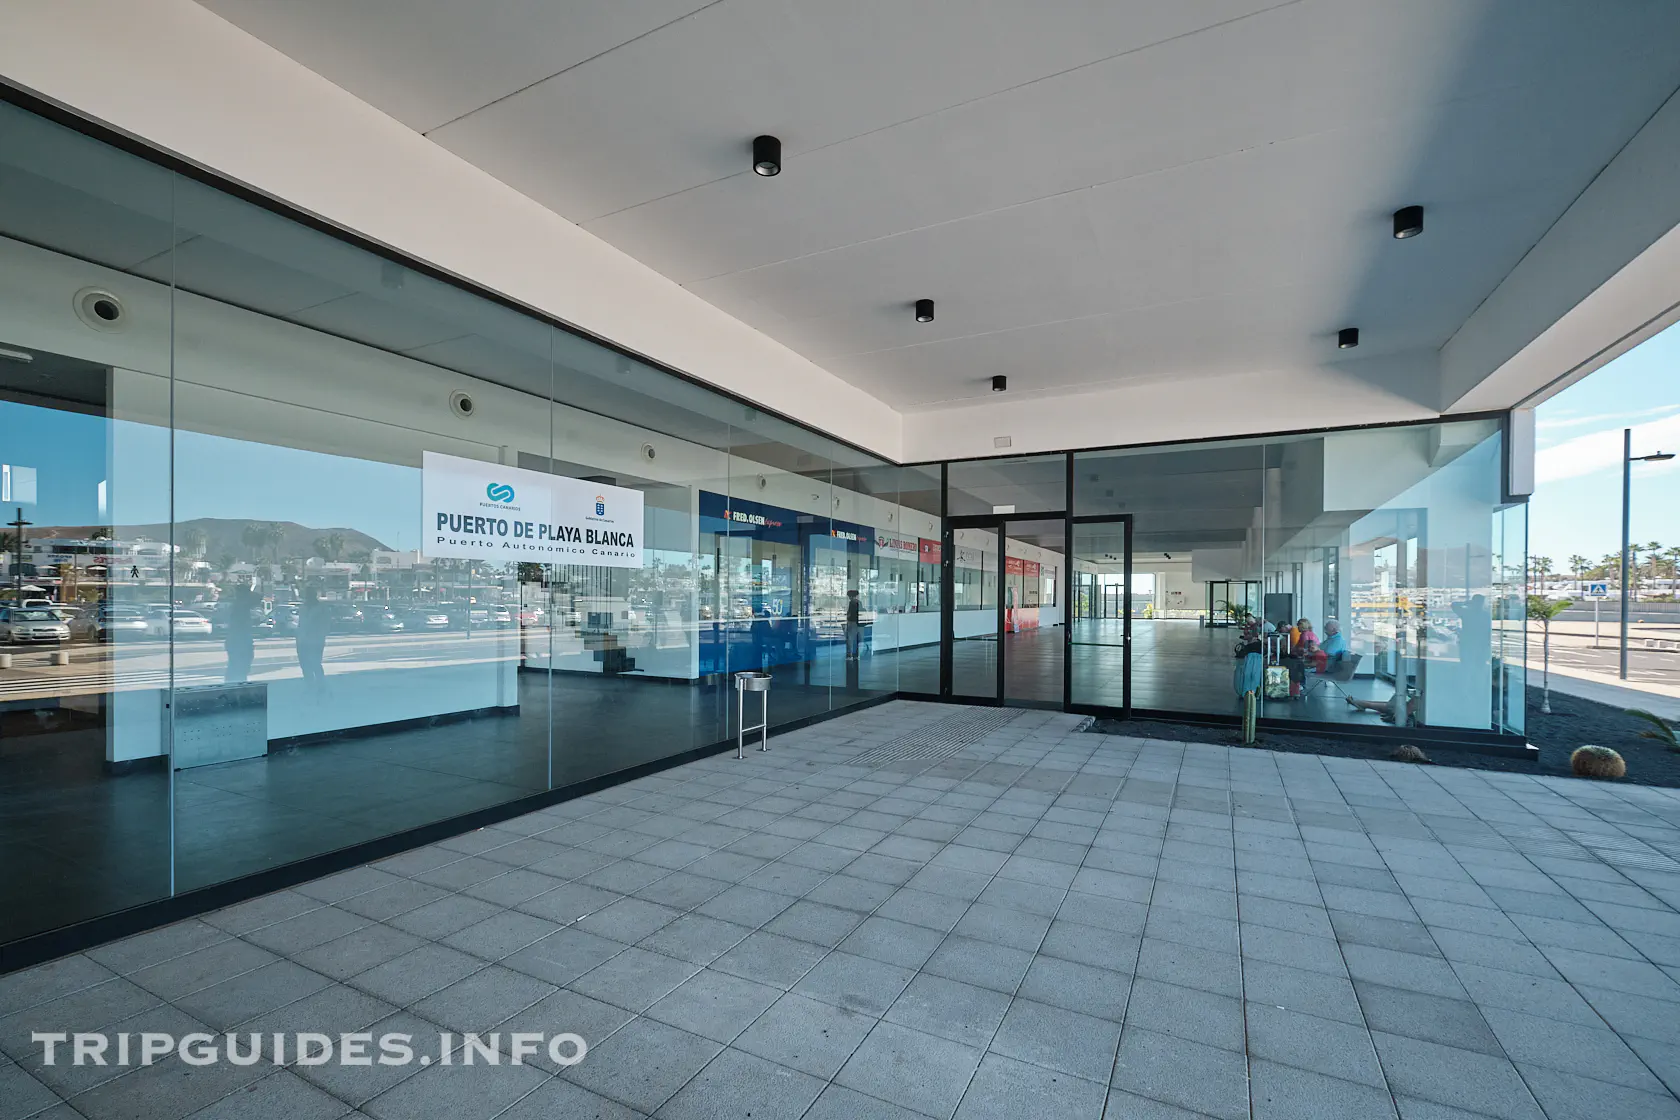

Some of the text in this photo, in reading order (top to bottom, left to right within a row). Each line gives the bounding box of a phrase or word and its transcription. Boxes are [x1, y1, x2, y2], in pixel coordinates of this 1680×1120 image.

[437, 512, 634, 548] PUERTO DE PLAYA BLANCA
[749, 514, 765, 526] OLSEN
[436, 536, 636, 558] Puerto Autonómico Canario
